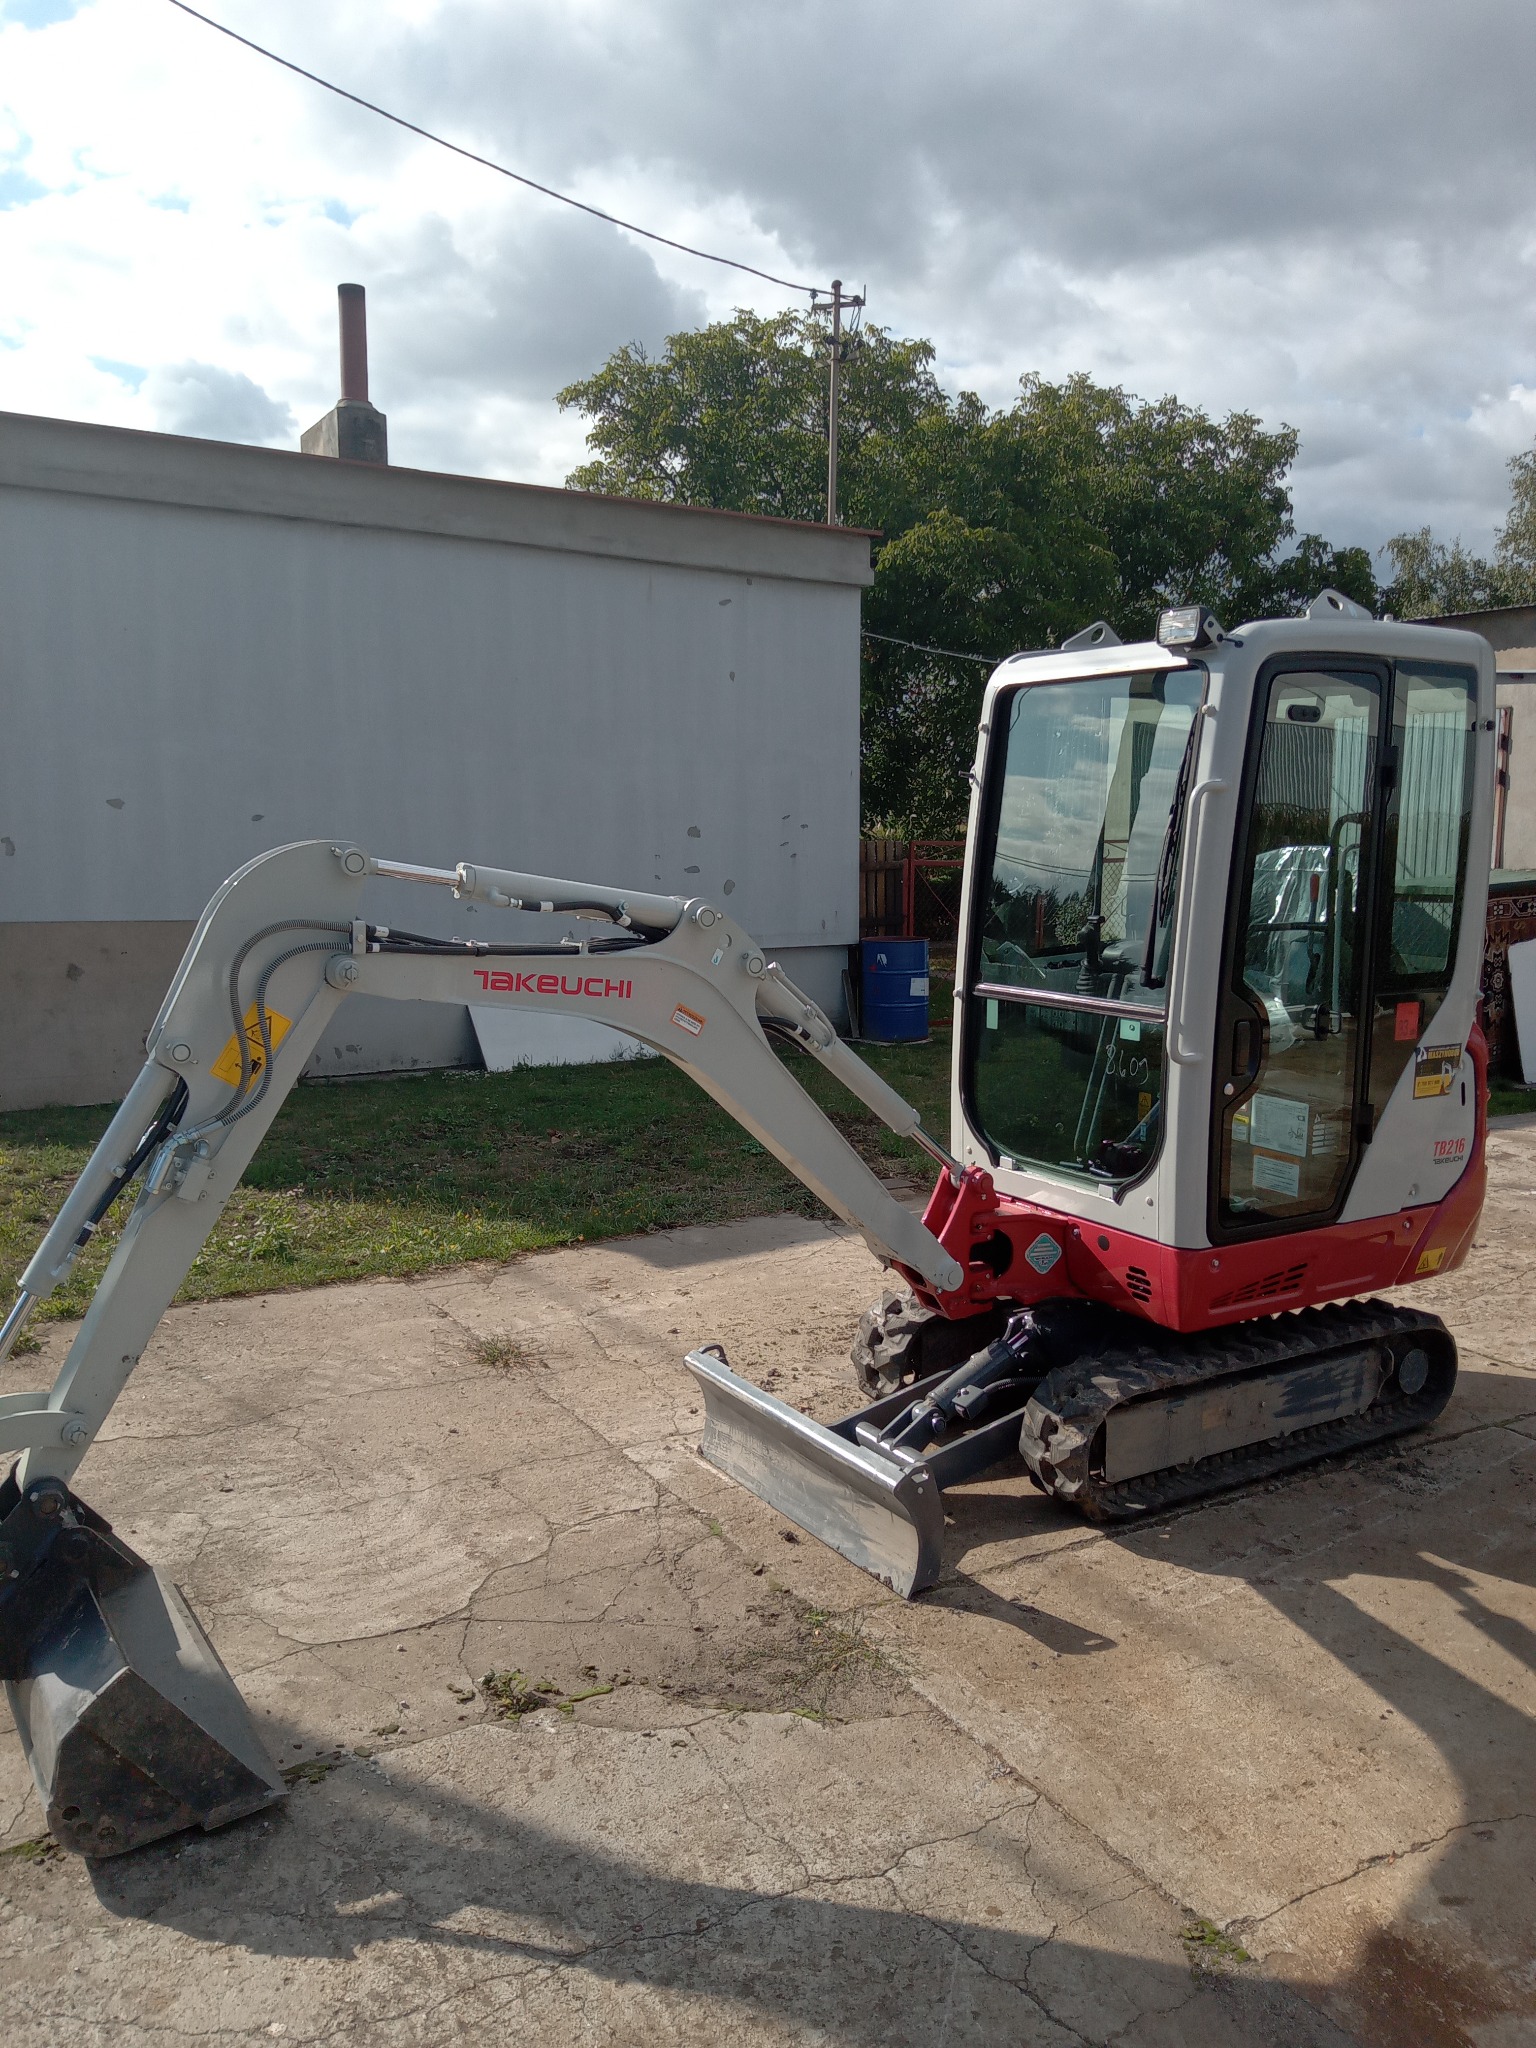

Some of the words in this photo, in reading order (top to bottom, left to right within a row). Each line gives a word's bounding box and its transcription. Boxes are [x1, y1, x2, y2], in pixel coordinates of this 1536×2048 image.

[473, 970, 632, 999] TAKEUCHI
[1433, 1137, 1466, 1158] TB216
[1433, 1154, 1464, 1165] TAKEUCHI
